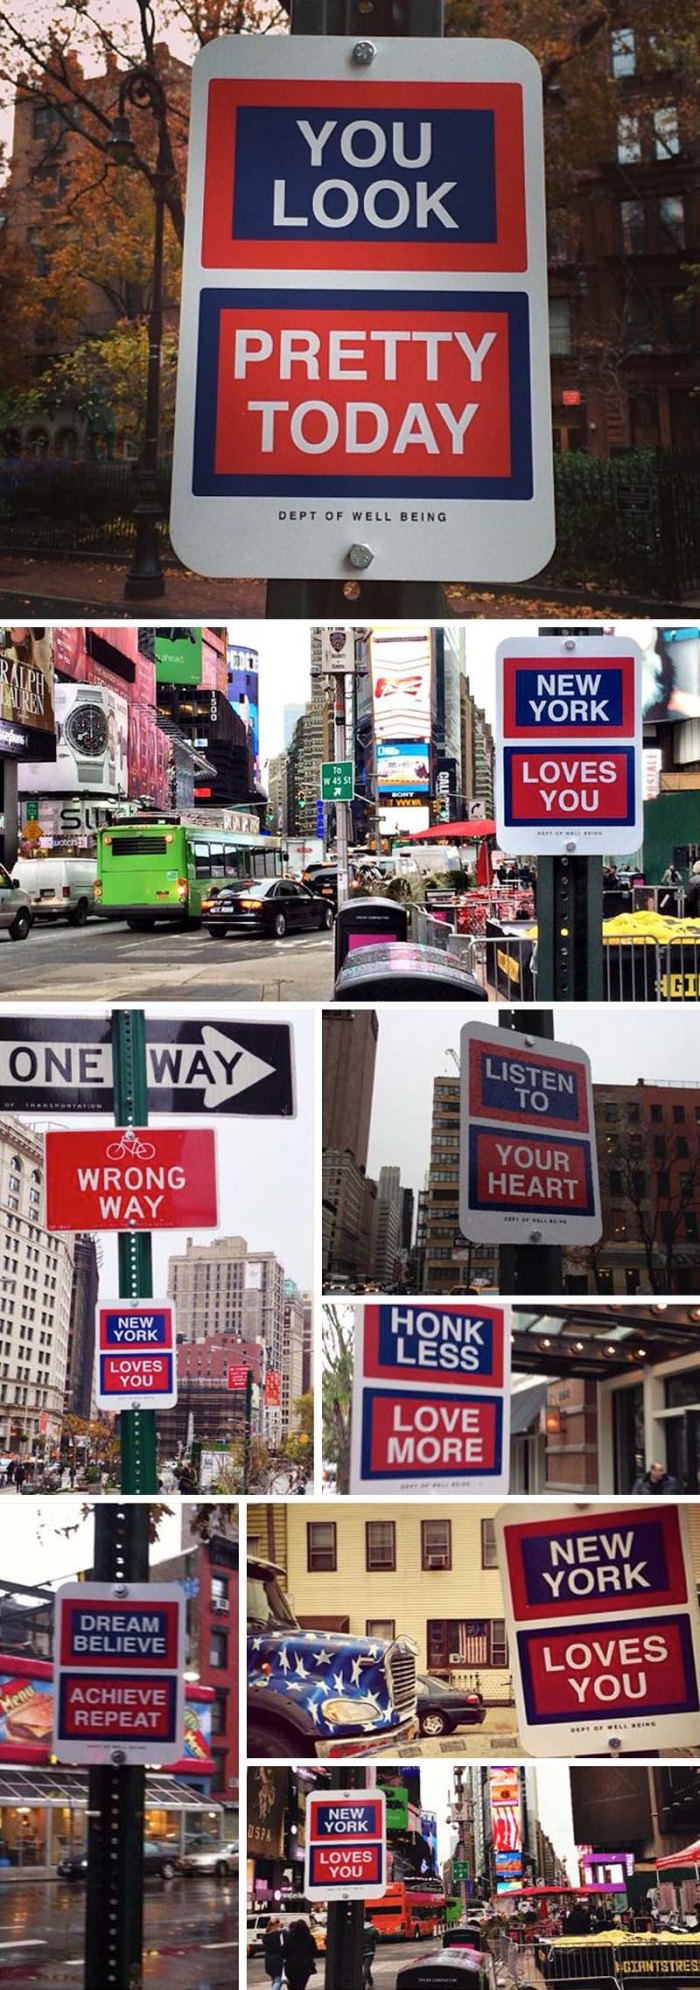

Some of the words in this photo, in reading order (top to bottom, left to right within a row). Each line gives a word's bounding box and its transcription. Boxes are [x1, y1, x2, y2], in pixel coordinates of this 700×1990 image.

[296, 119, 433, 168] YOU
[272, 178, 460, 230] LOOK
[233, 328, 498, 382] PRETTY
[247, 399, 480, 455] TODAY
[278, 511, 317, 521] DEPT
[325, 511, 343, 521] OF
[352, 512, 392, 522] WELL
[400, 512, 447, 522] BEING
[0, 659, 45, 697] RALPH
[536, 673, 602, 696] NEW
[0, 684, 45, 716] LAUREN
[210, 690, 218, 721] 1500
[528, 699, 610, 722] YORK
[323, 778, 331, 786] W
[332, 777, 343, 785] 45
[343, 776, 352, 785] St
[332, 766, 342, 775] To
[438, 771, 450, 794] CALL
[522, 761, 617, 783] LOVES
[539, 789, 600, 812] YOU
[654, 973, 700, 998] #GI
[9, 1047, 104, 1083] ONE
[150, 1049, 244, 1085] WAY
[485, 1057, 574, 1095] LISTEN
[514, 1087, 549, 1112] TO
[495, 1143, 571, 1172] YOUR
[77, 1166, 187, 1192] WRONG
[488, 1172, 579, 1200] HEART
[99, 1195, 164, 1220] WAY
[117, 1316, 154, 1329] NEW
[390, 1306, 485, 1345] HONK
[113, 1329, 159, 1342] YORK
[110, 1360, 163, 1374] LOVES
[396, 1338, 480, 1371] LESS
[119, 1374, 154, 1388] YOU
[392, 1405, 481, 1434] LOVE
[387, 1437, 484, 1464] MORE
[549, 1531, 635, 1567] NEW
[542, 1560, 651, 1598] YORK
[80, 1615, 160, 1634] DREAM
[73, 1636, 166, 1655] BELIEVE
[543, 1635, 668, 1672] LOVES
[70, 1687, 167, 1706] ACHIEVE
[568, 1671, 647, 1702] YOU
[74, 1710, 162, 1729] REPEAT
[324, 1820, 368, 1833] YORK
[328, 1808, 365, 1820] NEW
[319, 1851, 373, 1865] LOVES
[328, 1865, 363, 1878] YOU
[615, 1959, 700, 1974] #GIANTSTRES
